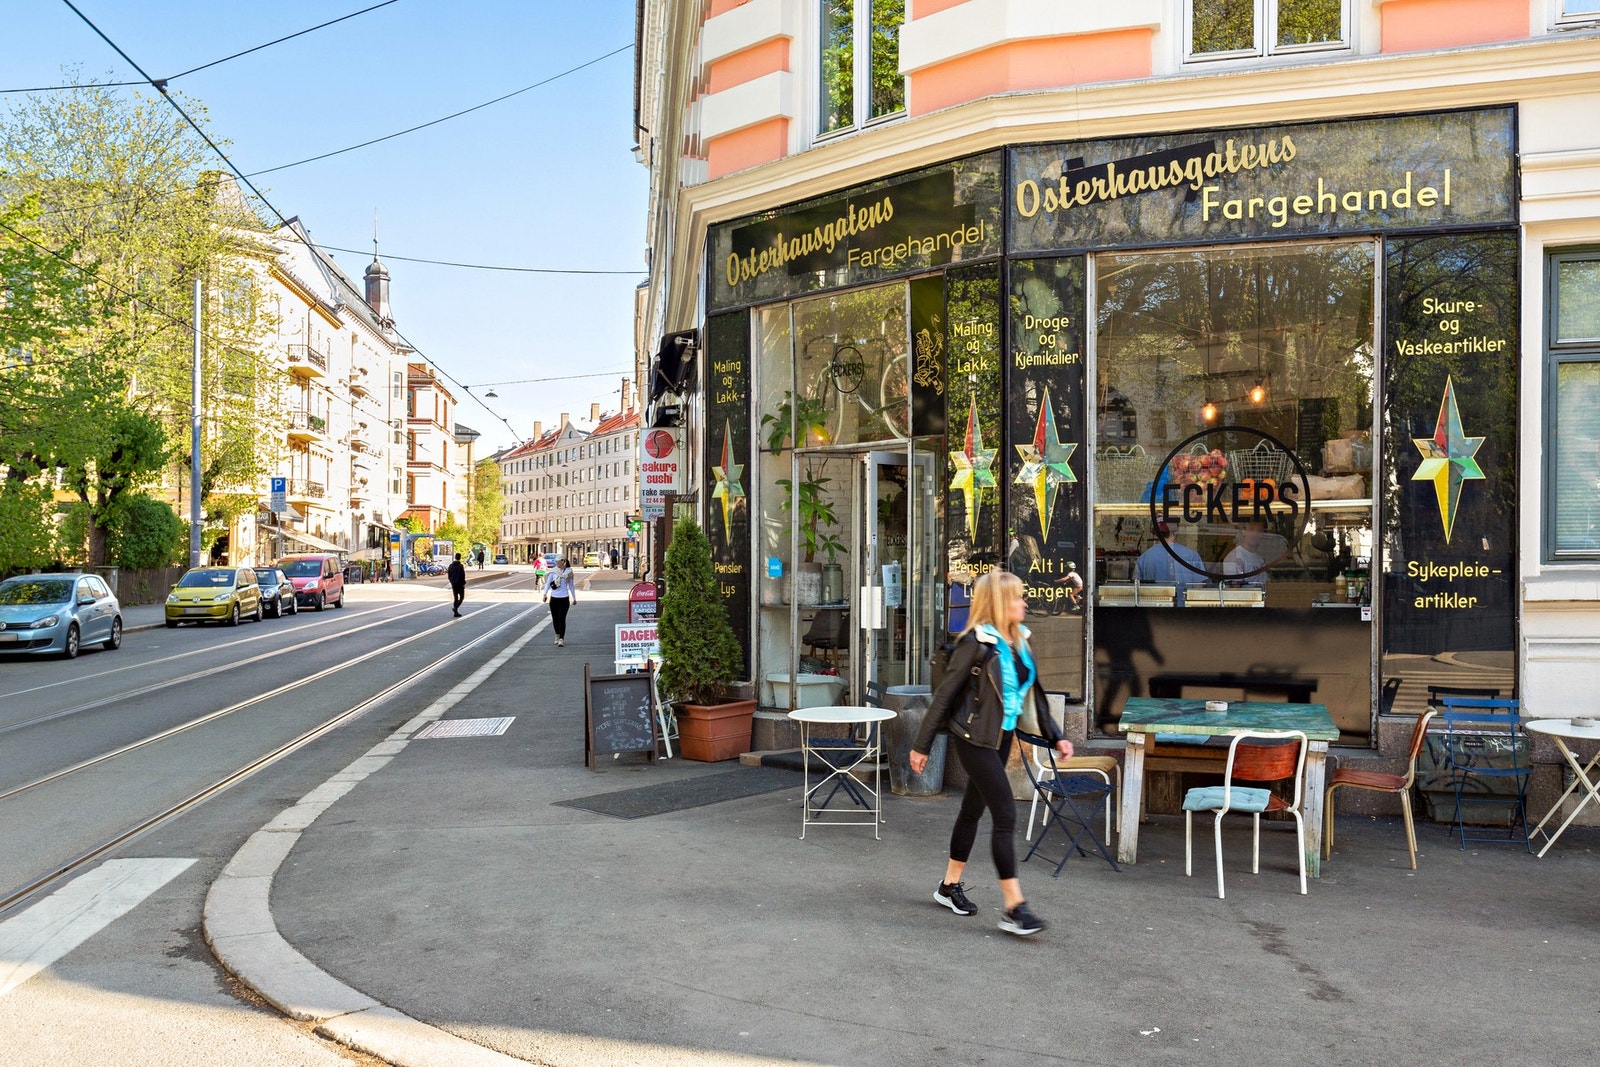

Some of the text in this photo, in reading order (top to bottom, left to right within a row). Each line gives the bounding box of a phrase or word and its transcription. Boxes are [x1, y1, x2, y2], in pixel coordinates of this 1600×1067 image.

[1016, 134, 1297, 218] Osterhausgatens
[1203, 169, 1452, 229] Fargehandel
[726, 196, 894, 287] Osterhausgatens
[847, 219, 985, 270] Fargehandel
[1422, 298, 1483, 315] Skure-
[953, 321, 993, 337] Maling
[1025, 315, 1070, 332] Droge
[1439, 319, 1460, 335] og
[966, 340, 980, 354] og
[1039, 333, 1056, 349] og
[1395, 336, 1506, 356] Vaskeartikler
[714, 360, 741, 373] Maling
[957, 357, 989, 373] Lakk
[1015, 350, 1079, 370] Kjemikalier
[834, 362, 862, 377] ECKERS
[722, 376, 732, 388] og
[716, 390, 738, 403] Lakk
[642, 461, 677, 472] sakura
[274, 479, 283, 490] P
[646, 473, 673, 484] sushi
[1162, 482, 1299, 524] ECKERS
[714, 562, 742, 574] Pensler
[1028, 558, 1064, 573] Alt i
[720, 581, 736, 598] Lys
[1414, 592, 1478, 609] artikler
